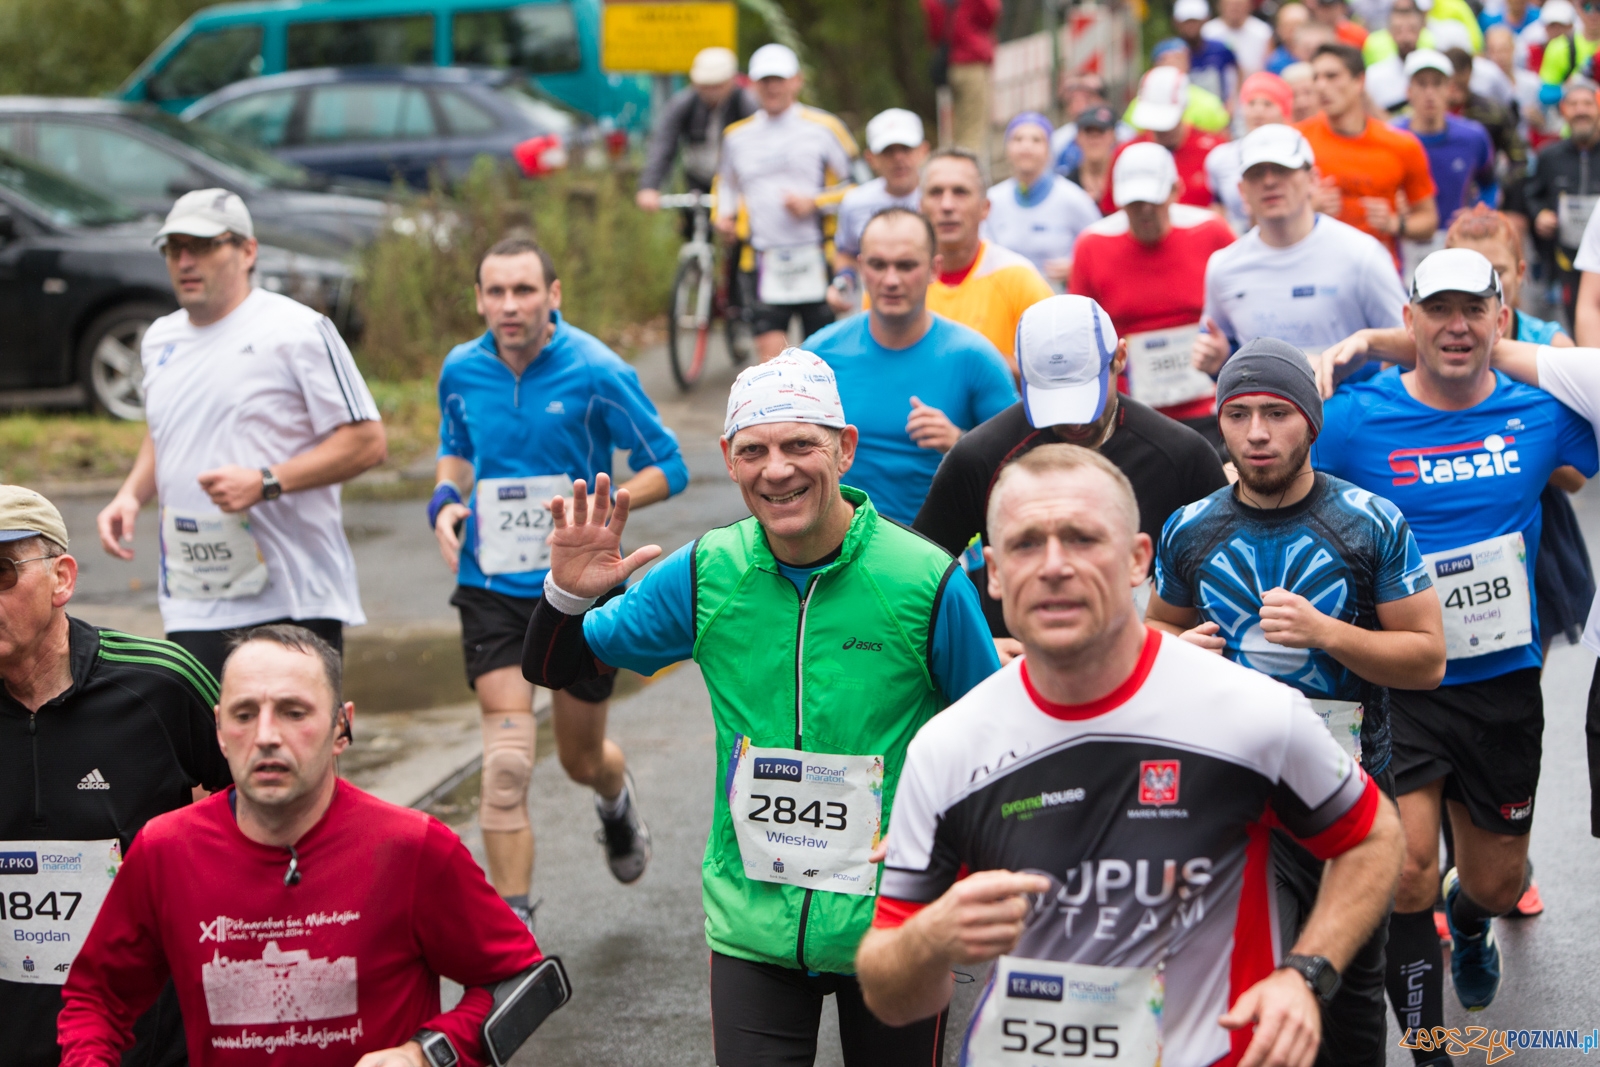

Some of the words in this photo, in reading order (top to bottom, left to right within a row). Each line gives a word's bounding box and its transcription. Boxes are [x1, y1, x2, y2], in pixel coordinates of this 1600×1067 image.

[1388, 434, 1521, 487] Staszic
[181, 542, 232, 562] 3015
[1444, 576, 1511, 609] 4138
[1463, 608, 1502, 625] Maciej
[855, 641, 883, 652] asics
[77, 782, 110, 790] adidas
[805, 774, 845, 783] maraton
[748, 794, 848, 831] 2843
[766, 830, 828, 849] Wiesław
[42, 862, 82, 871] maraton
[0, 891, 82, 920] 1847
[1058, 894, 1205, 940] TEAM
[14, 929, 70, 944] Bogdan
[199, 915, 226, 943] XII
[54, 963, 70, 972] 4F
[1002, 1018, 1119, 1059] 5295
